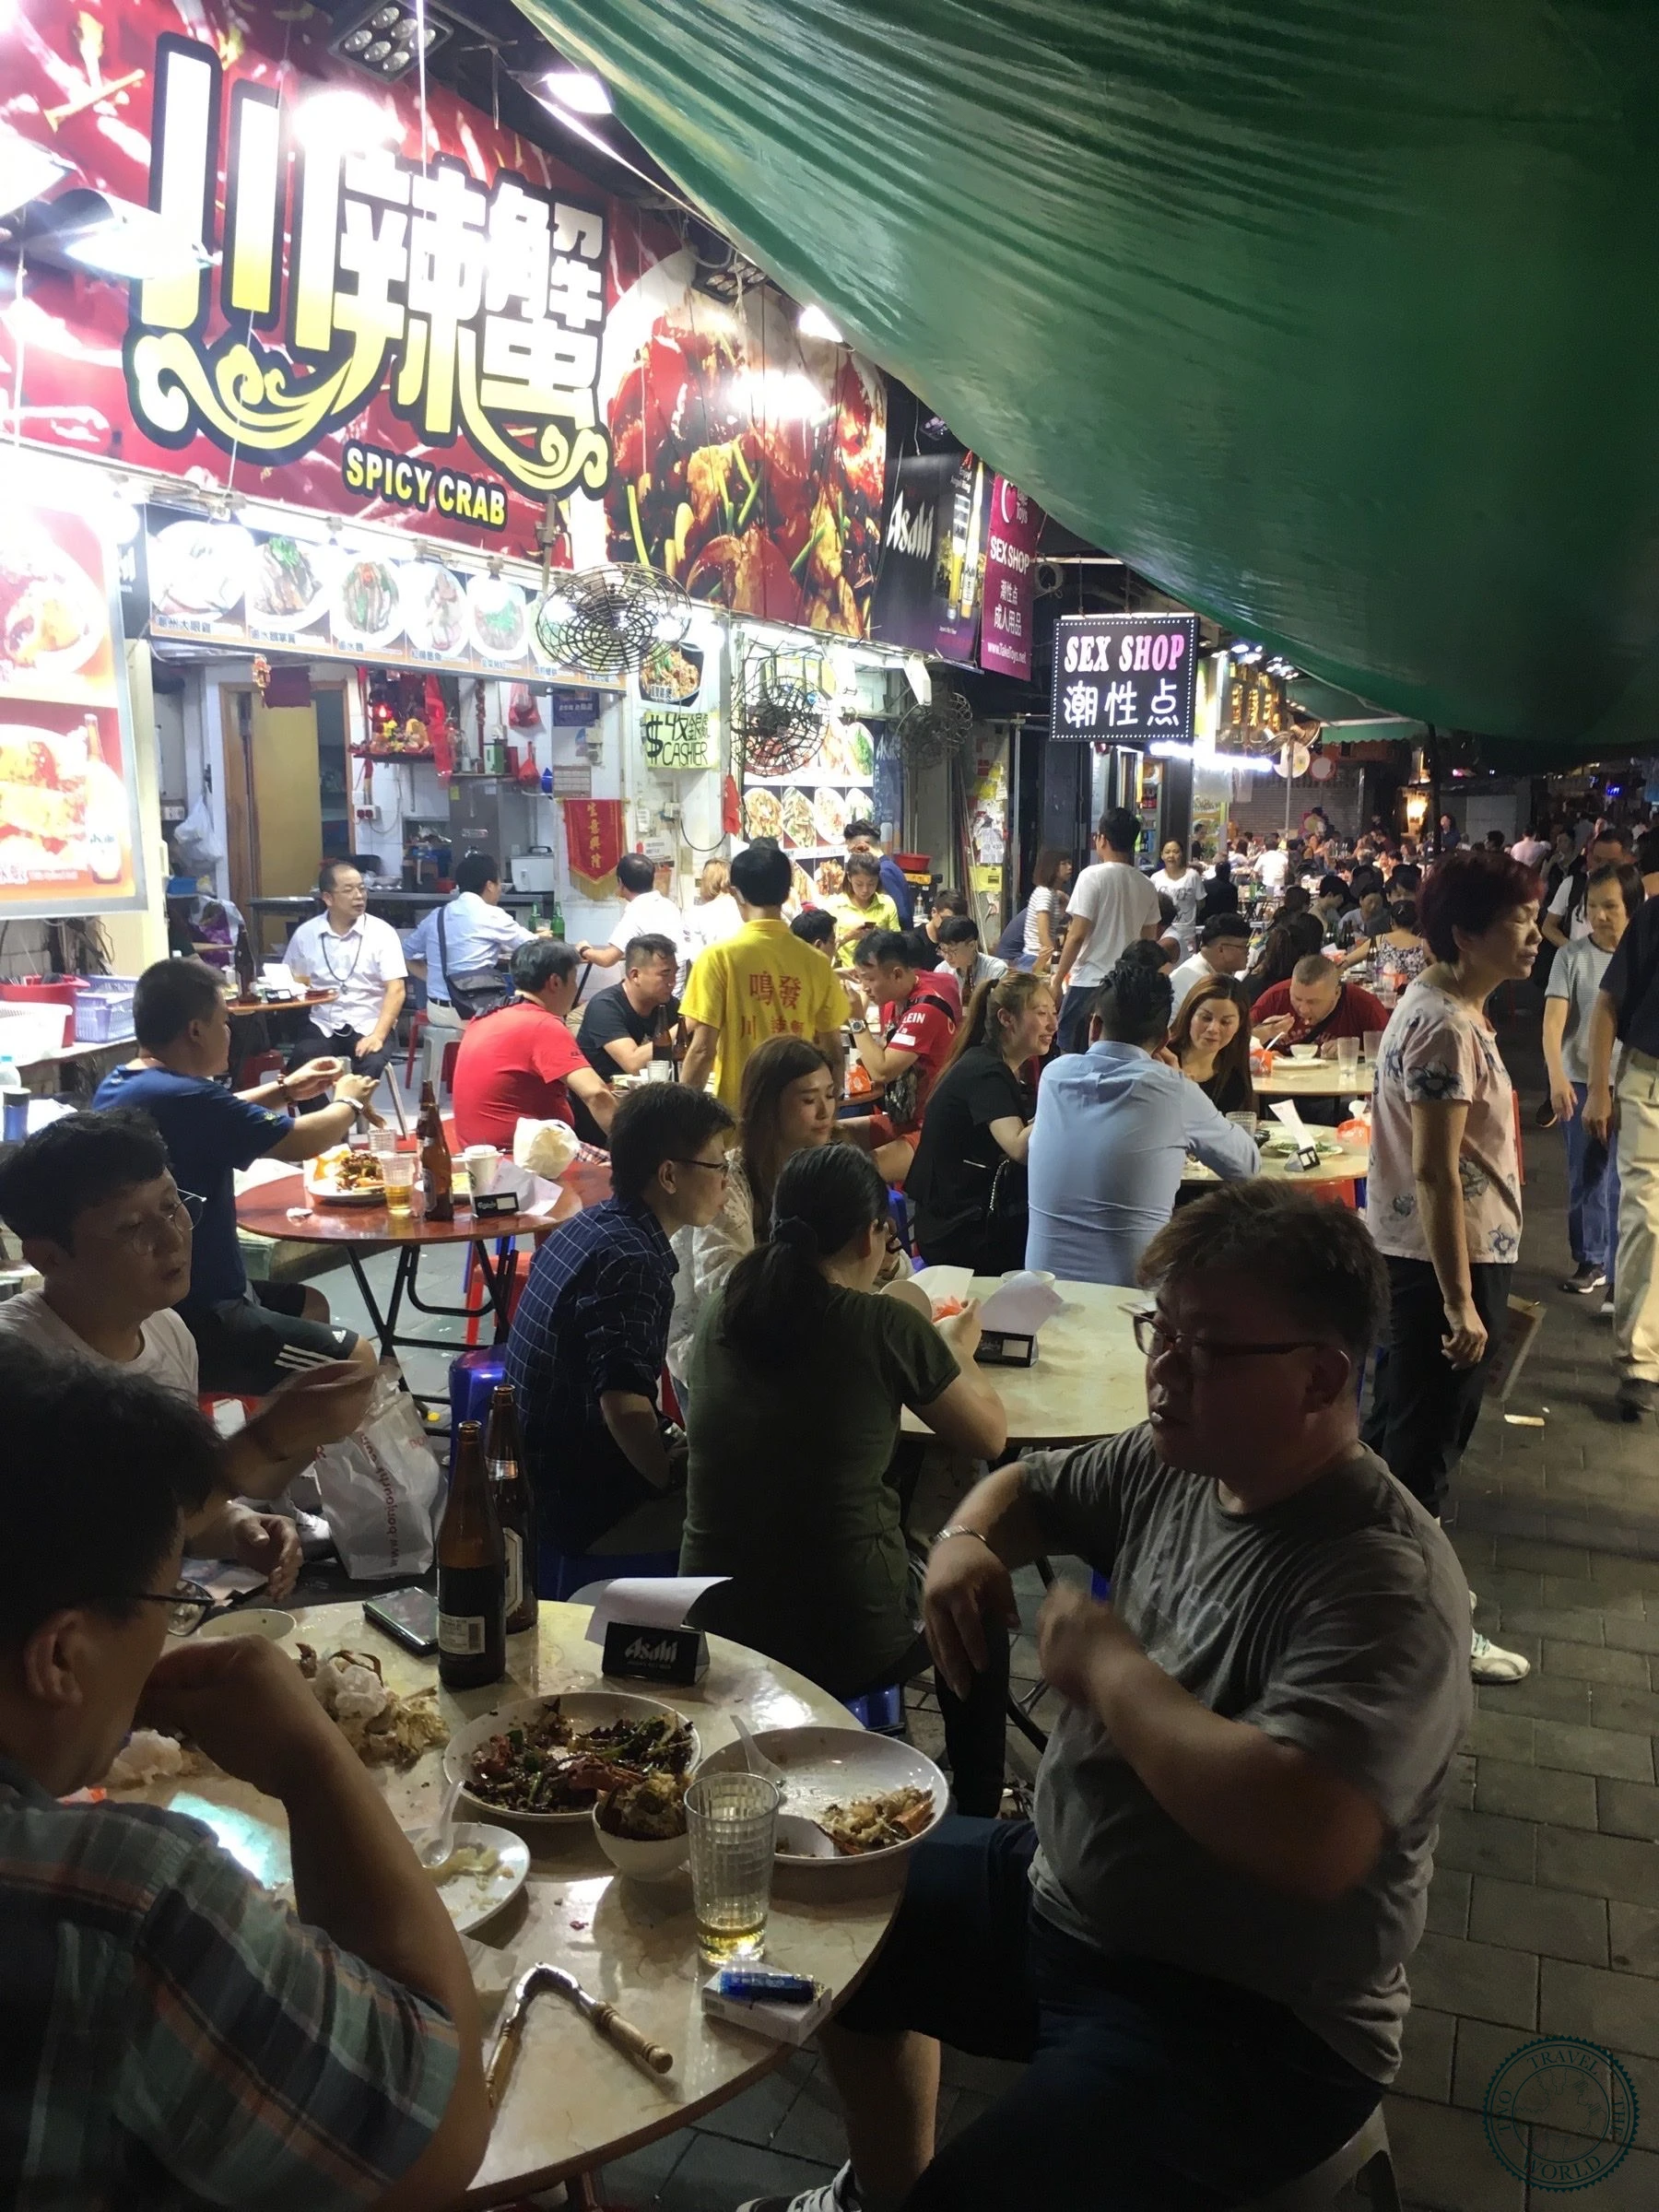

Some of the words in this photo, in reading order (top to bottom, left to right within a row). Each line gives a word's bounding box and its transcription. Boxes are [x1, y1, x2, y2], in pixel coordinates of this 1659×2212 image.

[135, 50, 608, 490] 川辣蟹
[346, 446, 432, 505] SPICY
[438, 474, 505, 525] CRAB
[886, 488, 935, 560] Asahi
[989, 535, 1007, 566] SEX
[1007, 547, 1030, 575] SHOP
[994, 604, 1022, 637] 成人用品
[1064, 635, 1112, 673] SEX
[1118, 634, 1185, 672] SHOP
[1063, 677, 1180, 729] 潮性点
[624, 1635, 680, 1665] Asahi
